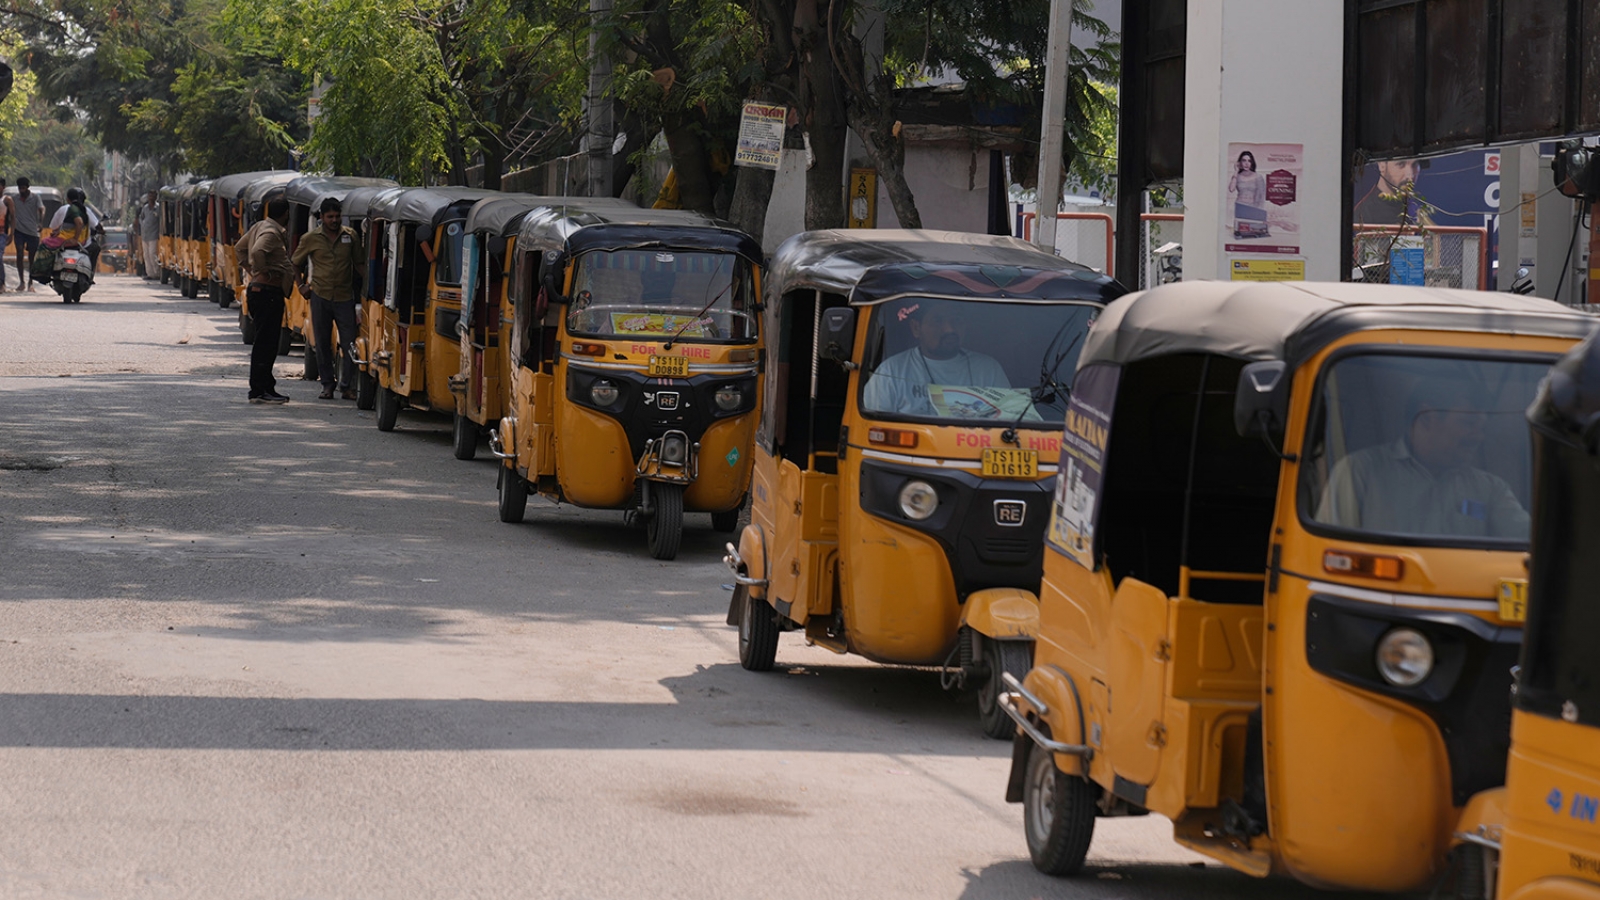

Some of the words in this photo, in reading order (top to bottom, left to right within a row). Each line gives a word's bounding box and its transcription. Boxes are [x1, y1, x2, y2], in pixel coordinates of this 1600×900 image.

[632, 345, 656, 355] FOR
[681, 347, 711, 359] HIRE
[656, 357, 684, 365] TS11U
[661, 397, 675, 407] RE
[956, 433, 991, 448] FOR
[1029, 436, 1063, 452] HIR
[991, 450, 1031, 461] TS11U
[992, 464, 1031, 475] D1613
[1000, 509, 1020, 521] RE
[1546, 787, 1563, 815] 4
[1569, 792, 1599, 824] IN
